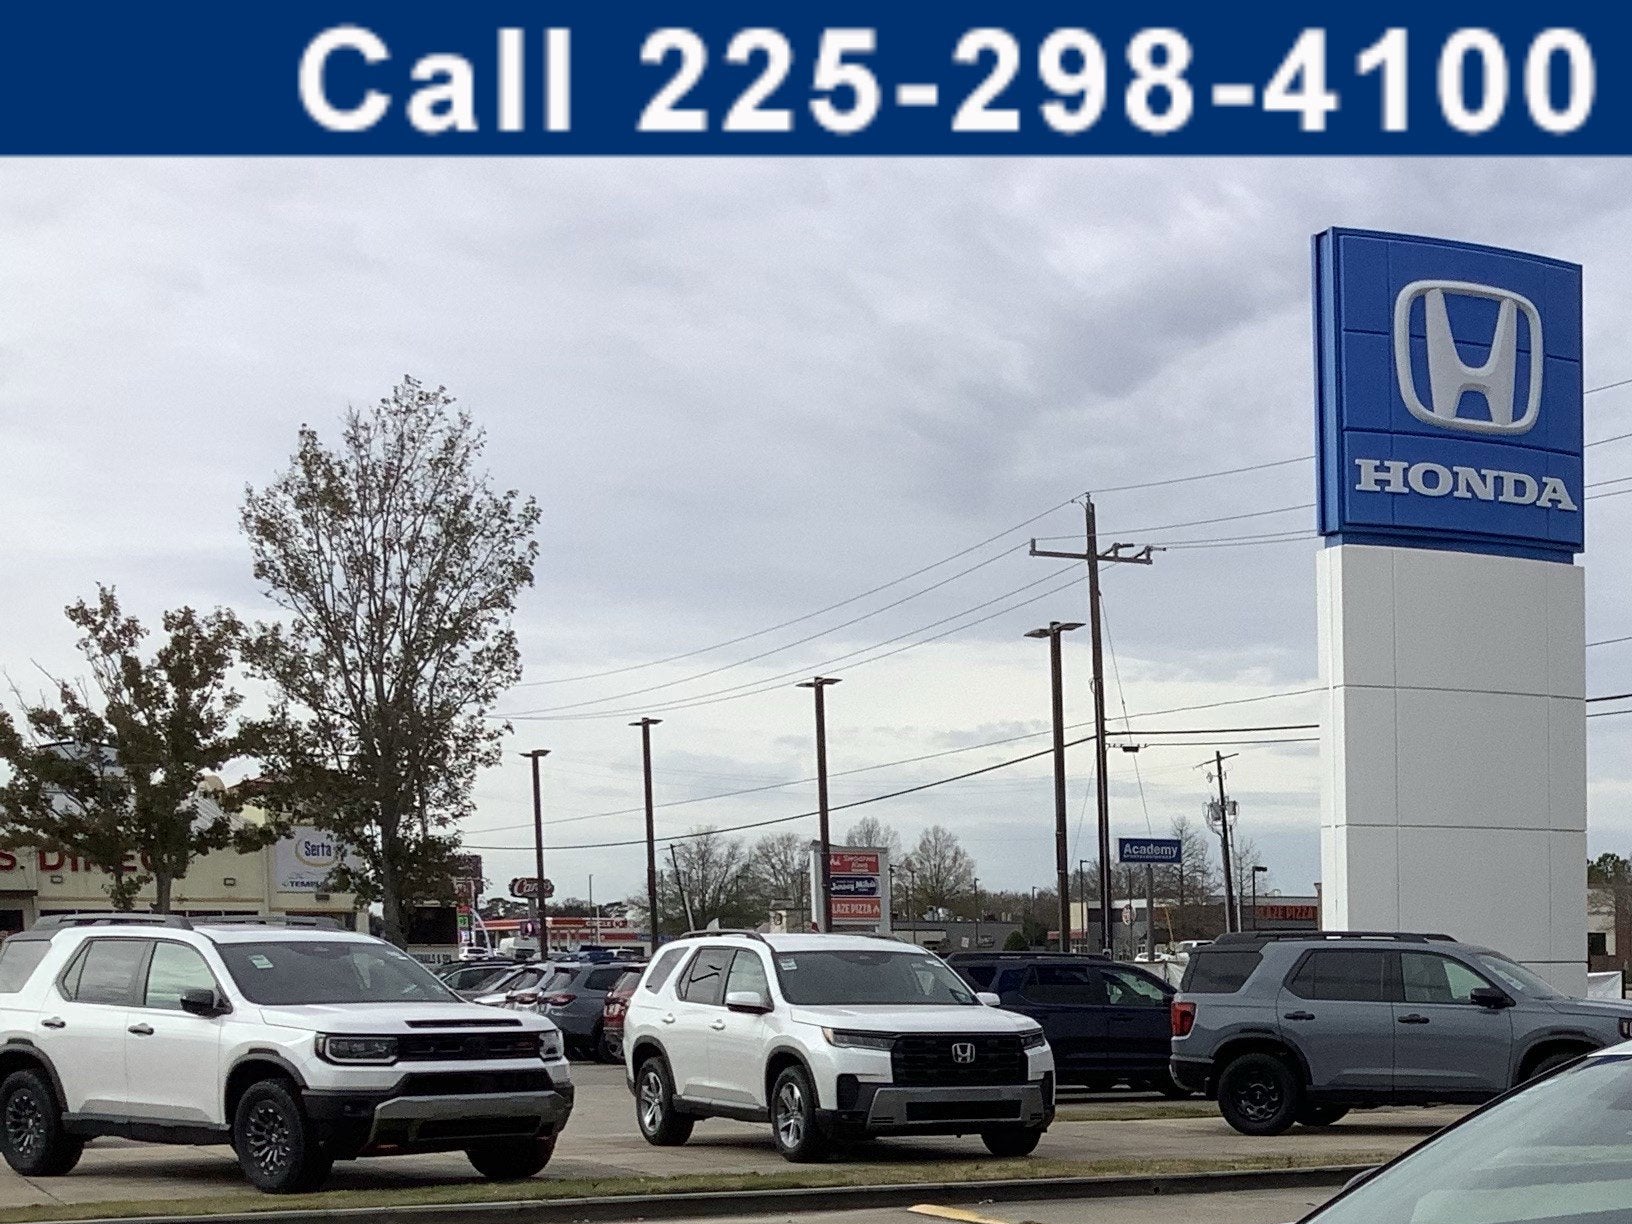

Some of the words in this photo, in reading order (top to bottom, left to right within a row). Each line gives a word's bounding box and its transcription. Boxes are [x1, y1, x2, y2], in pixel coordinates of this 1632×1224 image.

[1355, 459, 1578, 511] HONDA
[304, 841, 331, 856] Serta
[1123, 842, 1178, 858] Academy
[832, 904, 849, 914] LAZE
[850, 904, 872, 914] PIZZA
